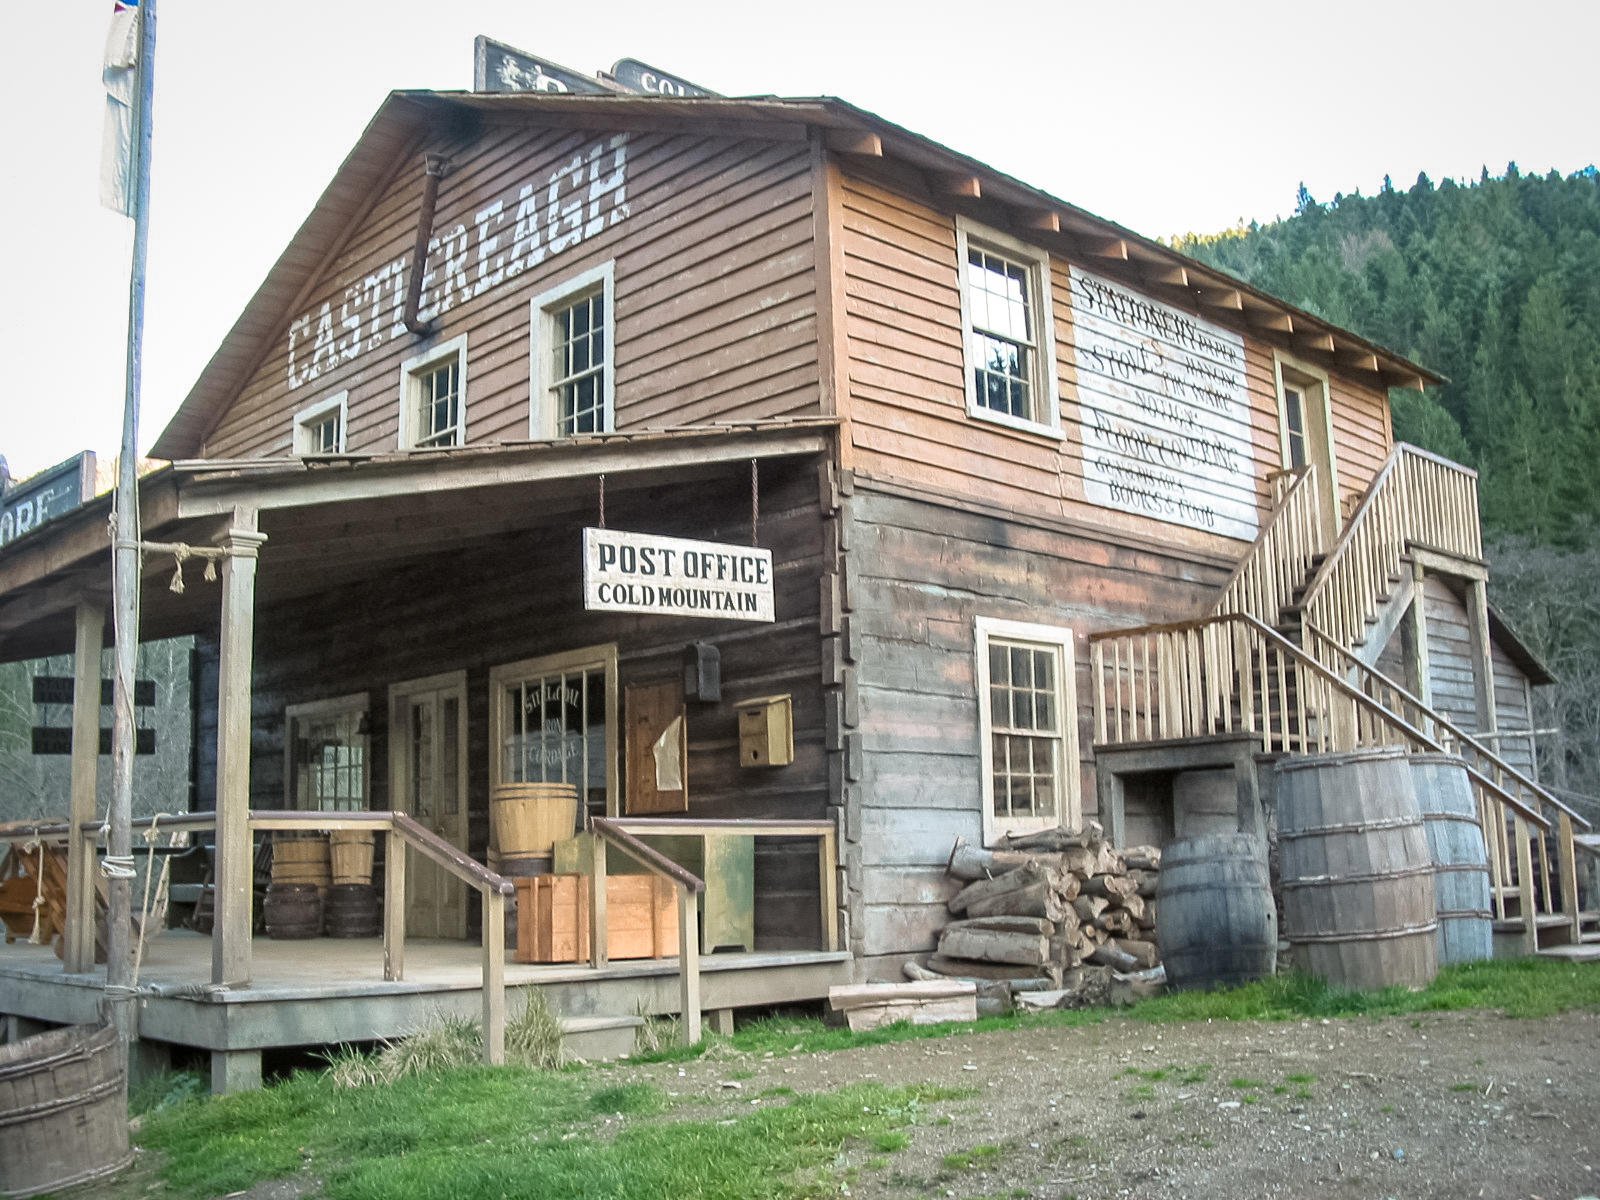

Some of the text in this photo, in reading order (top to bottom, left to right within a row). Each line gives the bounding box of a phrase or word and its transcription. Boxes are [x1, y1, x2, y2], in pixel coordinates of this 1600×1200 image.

[288, 132, 631, 390] CASTLEREAGH
[1079, 276, 1237, 365] STATIONERY PAPER
[1092, 339, 1166, 380] STOVES
[1185, 356, 1240, 392] HANGING
[1162, 371, 1233, 413] TIN WARE
[1093, 407, 1156, 464] FLOOR
[1108, 479, 1163, 514] BOOKS
[1177, 498, 1215, 528] FOOD
[598, 543, 768, 585] POST OFFICE
[598, 583, 758, 612] COLD MOUNTAIN
